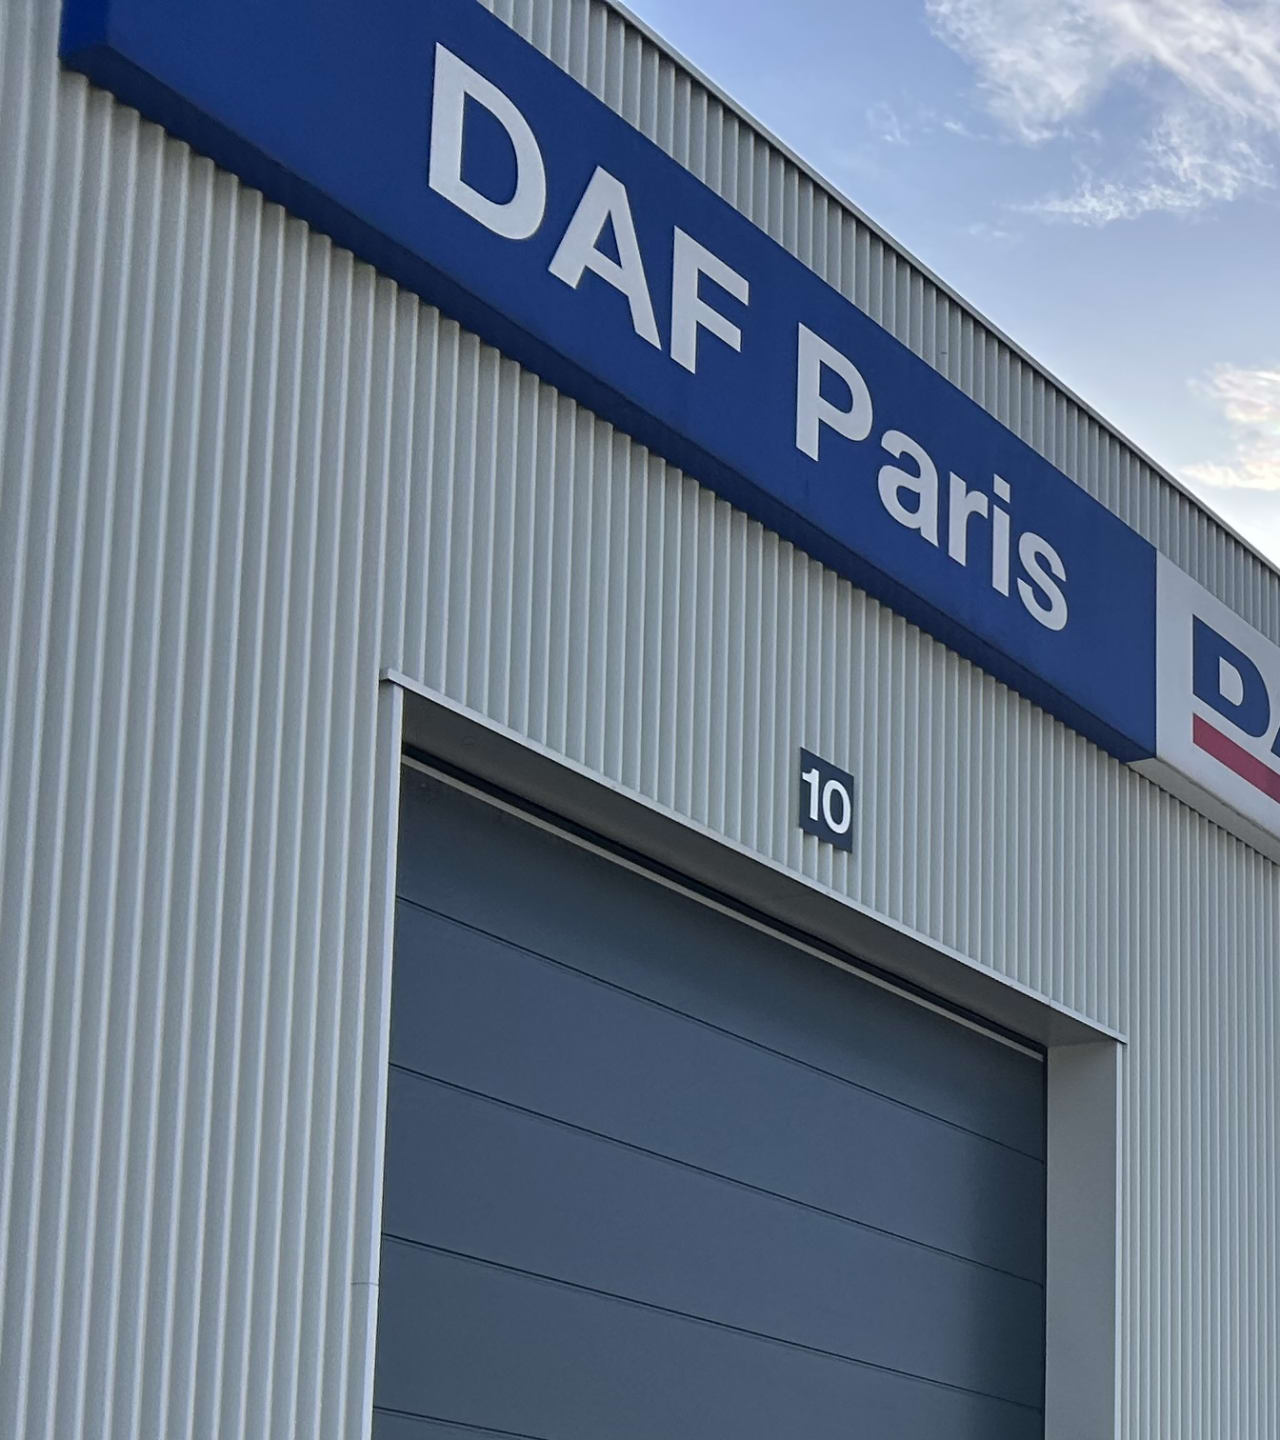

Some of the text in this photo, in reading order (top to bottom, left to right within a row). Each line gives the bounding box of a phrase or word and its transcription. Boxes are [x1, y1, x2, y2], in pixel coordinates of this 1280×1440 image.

[429, 42, 1068, 631] DAF Paris
[802, 768, 851, 834] 10
